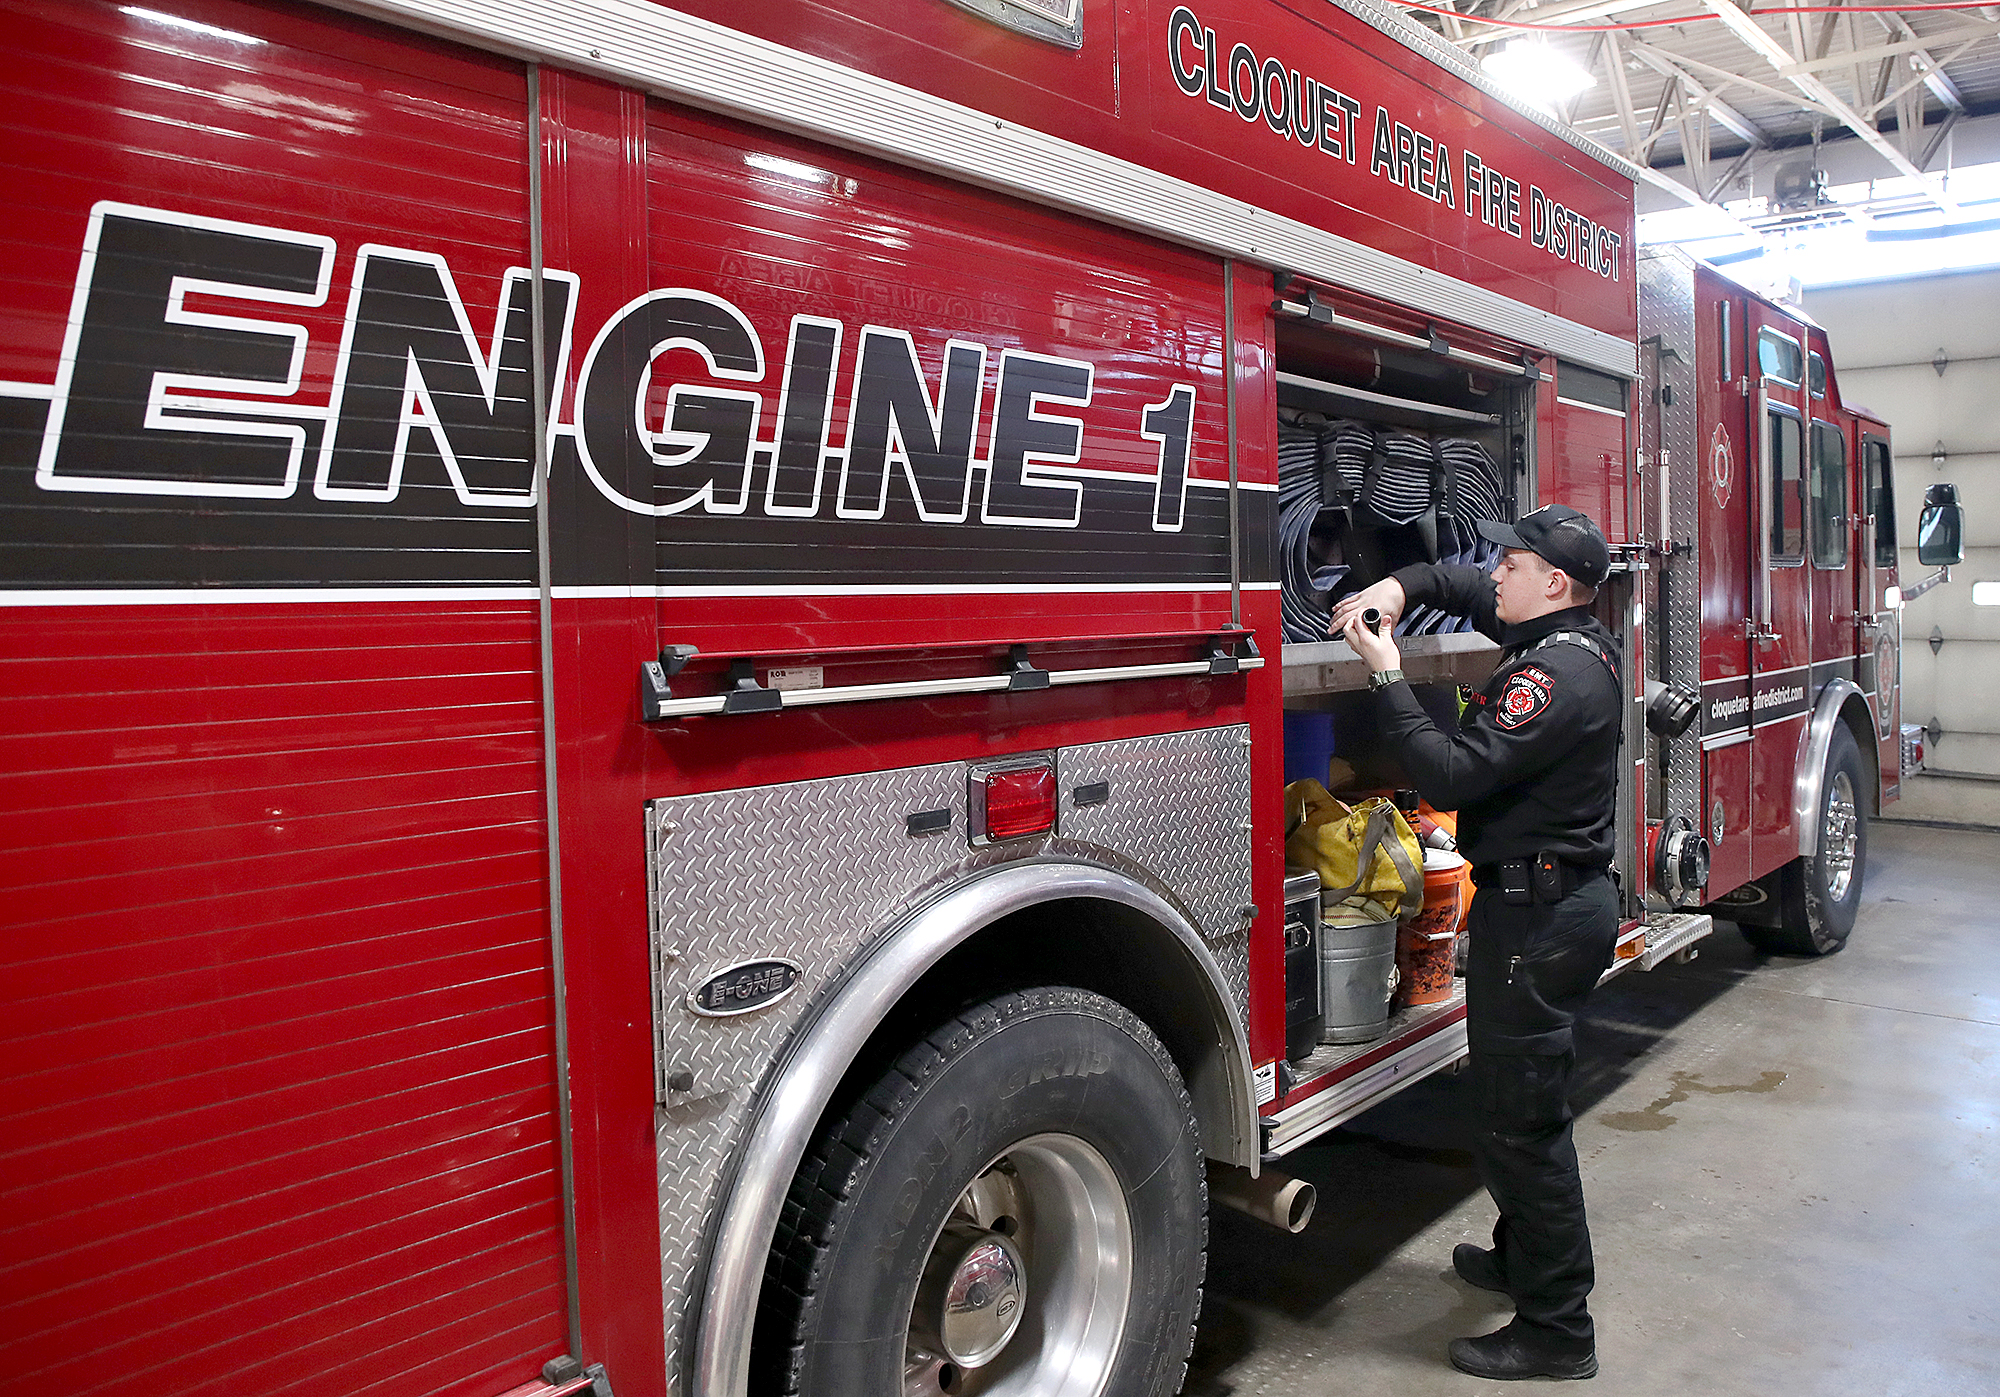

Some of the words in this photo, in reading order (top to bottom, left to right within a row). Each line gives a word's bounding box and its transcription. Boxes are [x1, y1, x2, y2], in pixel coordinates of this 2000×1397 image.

[1168, 6, 1360, 164] CLOQUET
[1371, 106, 1455, 210] AREA
[1463, 149, 1521, 239] FIRE
[1530, 184, 1622, 283] DISTRICT
[36, 200, 1096, 528] ENGINE
[1140, 383, 1197, 532] 1
[1529, 668, 1550, 684] EMT
[709, 966, 786, 1008] E-ONE
[999, 1049, 1112, 1100] GRIP
